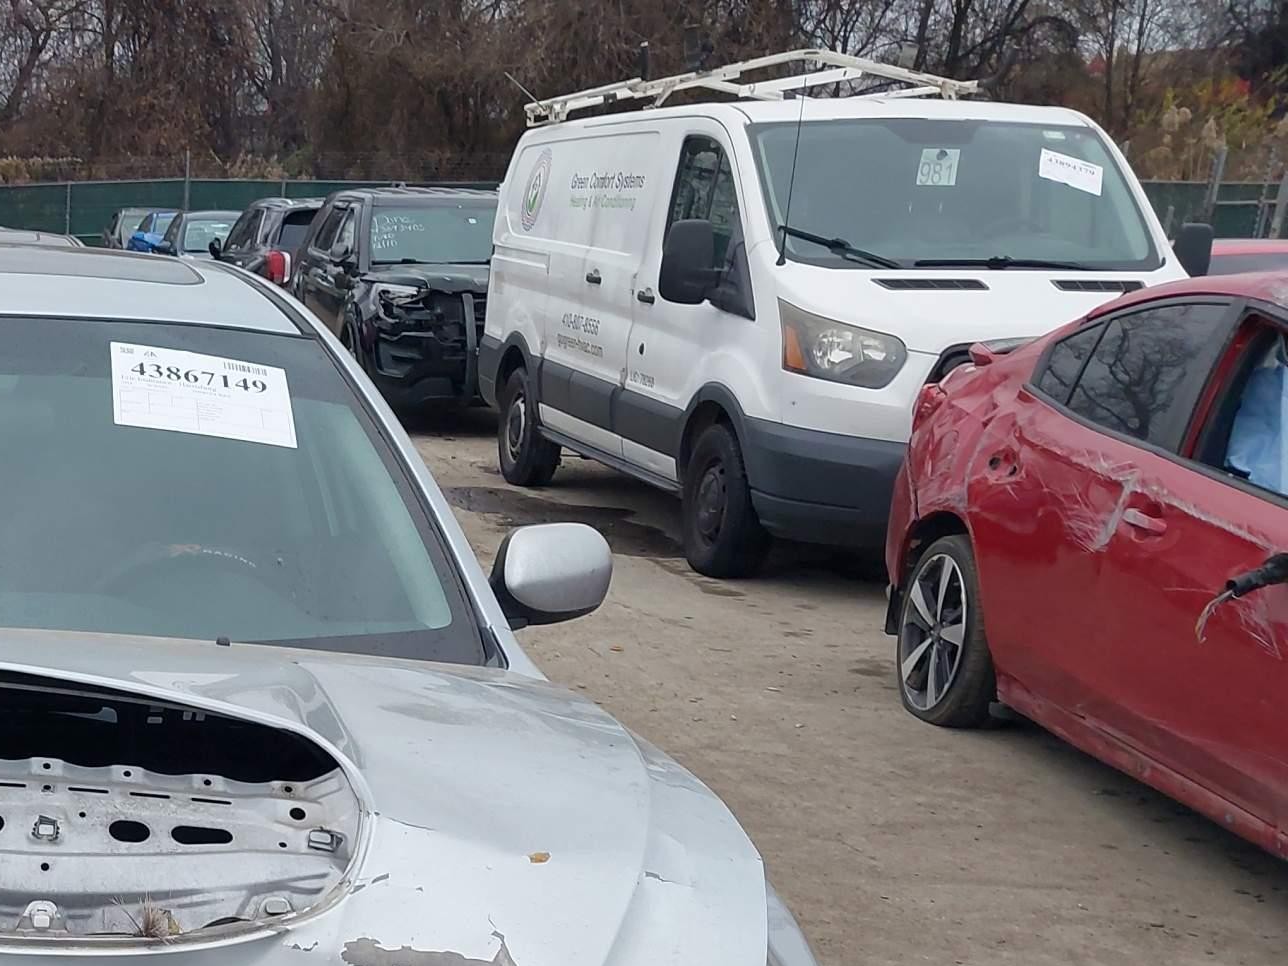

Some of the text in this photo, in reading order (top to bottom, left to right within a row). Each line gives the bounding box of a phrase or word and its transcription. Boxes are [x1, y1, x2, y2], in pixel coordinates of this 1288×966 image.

[571, 171, 646, 192] Green Comfort Systems
[919, 161, 953, 185] 981
[131, 362, 268, 394] 43867149
